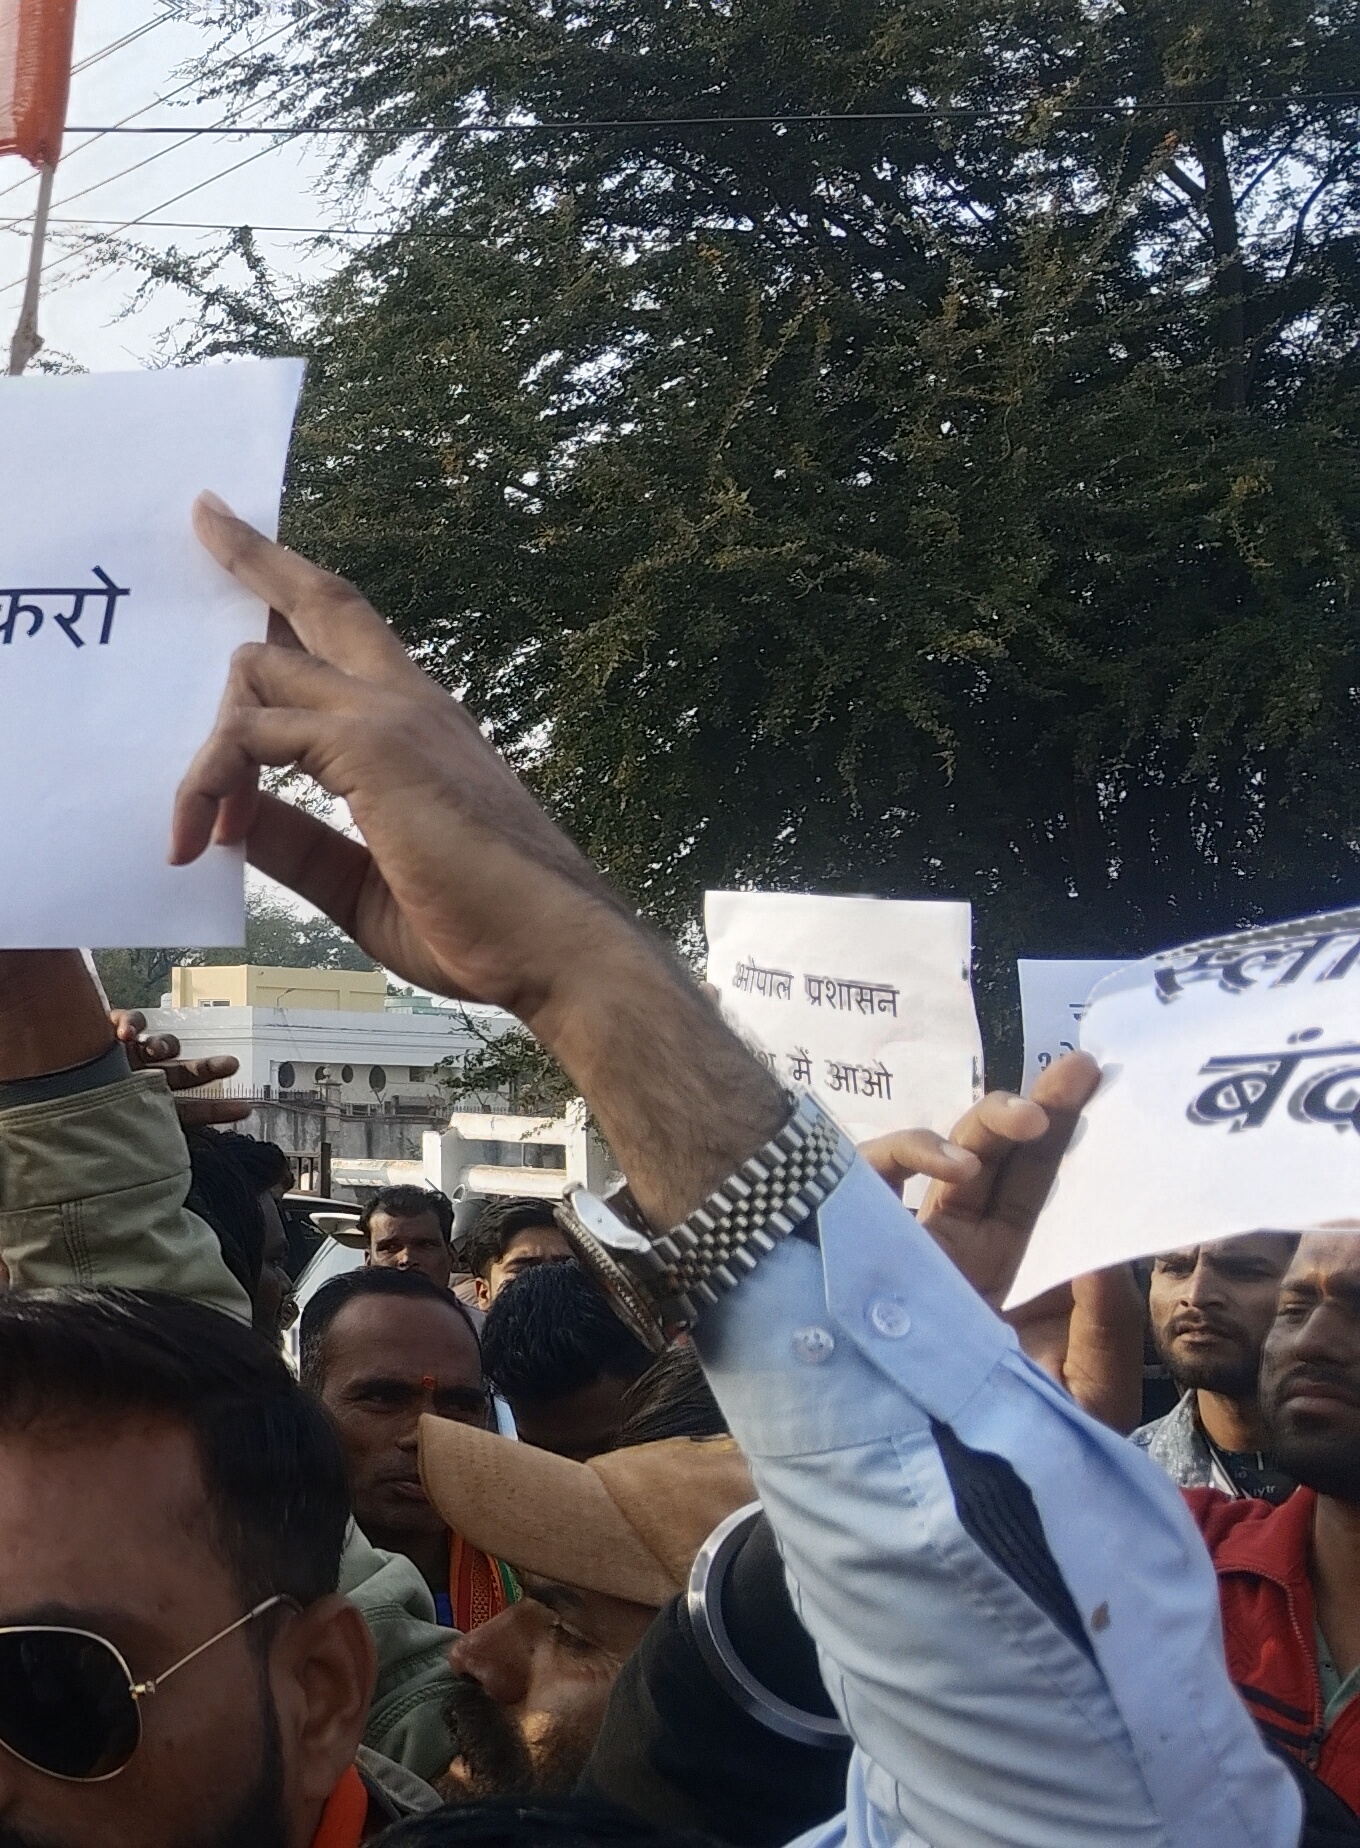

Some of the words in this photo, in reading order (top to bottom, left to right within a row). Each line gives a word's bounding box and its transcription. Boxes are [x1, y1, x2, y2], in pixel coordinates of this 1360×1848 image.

[733, 955, 795, 1001] भोपाल
[804, 974, 900, 1018] प्रशासन
[786, 1046, 814, 1086] में
[825, 1060, 893, 1101] आओ
